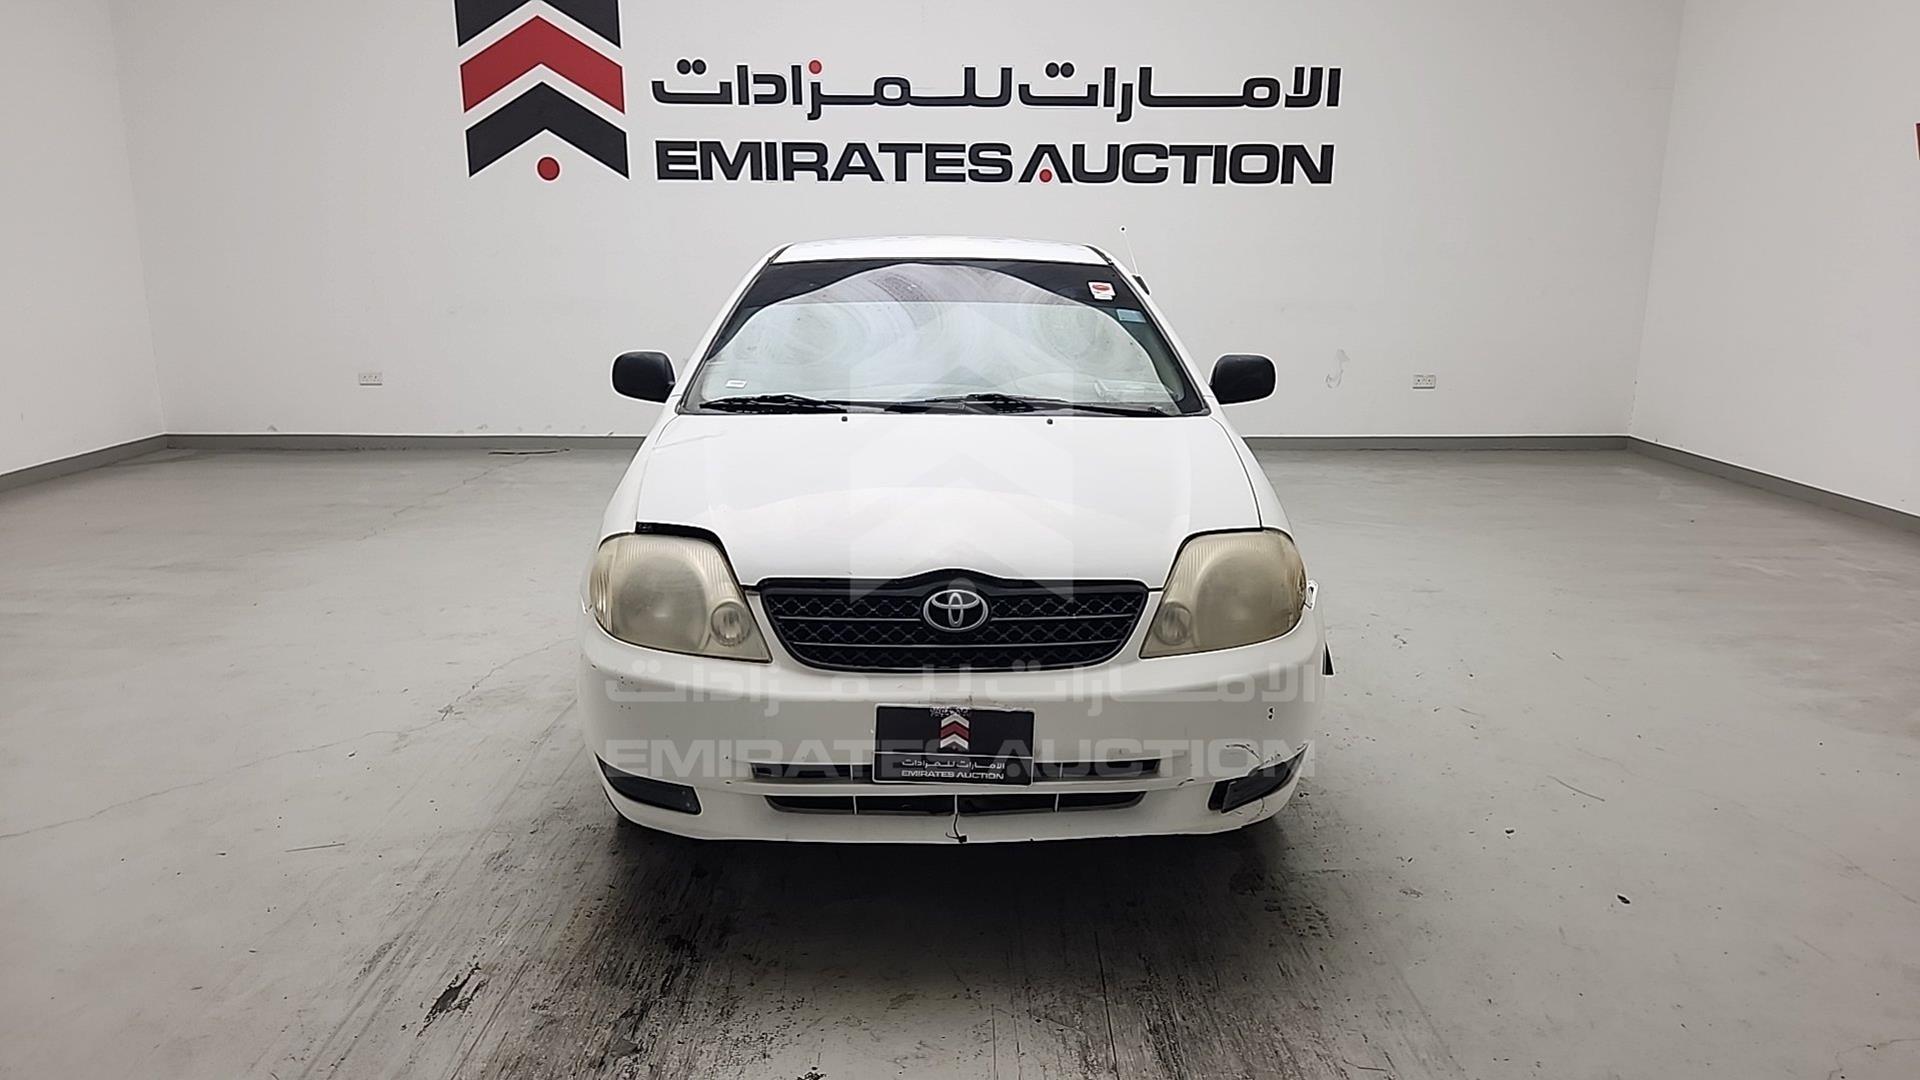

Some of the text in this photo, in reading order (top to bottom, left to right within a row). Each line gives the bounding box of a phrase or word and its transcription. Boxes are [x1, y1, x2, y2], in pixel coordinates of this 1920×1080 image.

[651, 58, 1342, 123] الامارات للمزادات
[655, 139, 1335, 185] EMIRATES AUCTION
[901, 770, 1004, 779] EMIRATES AUCTION
